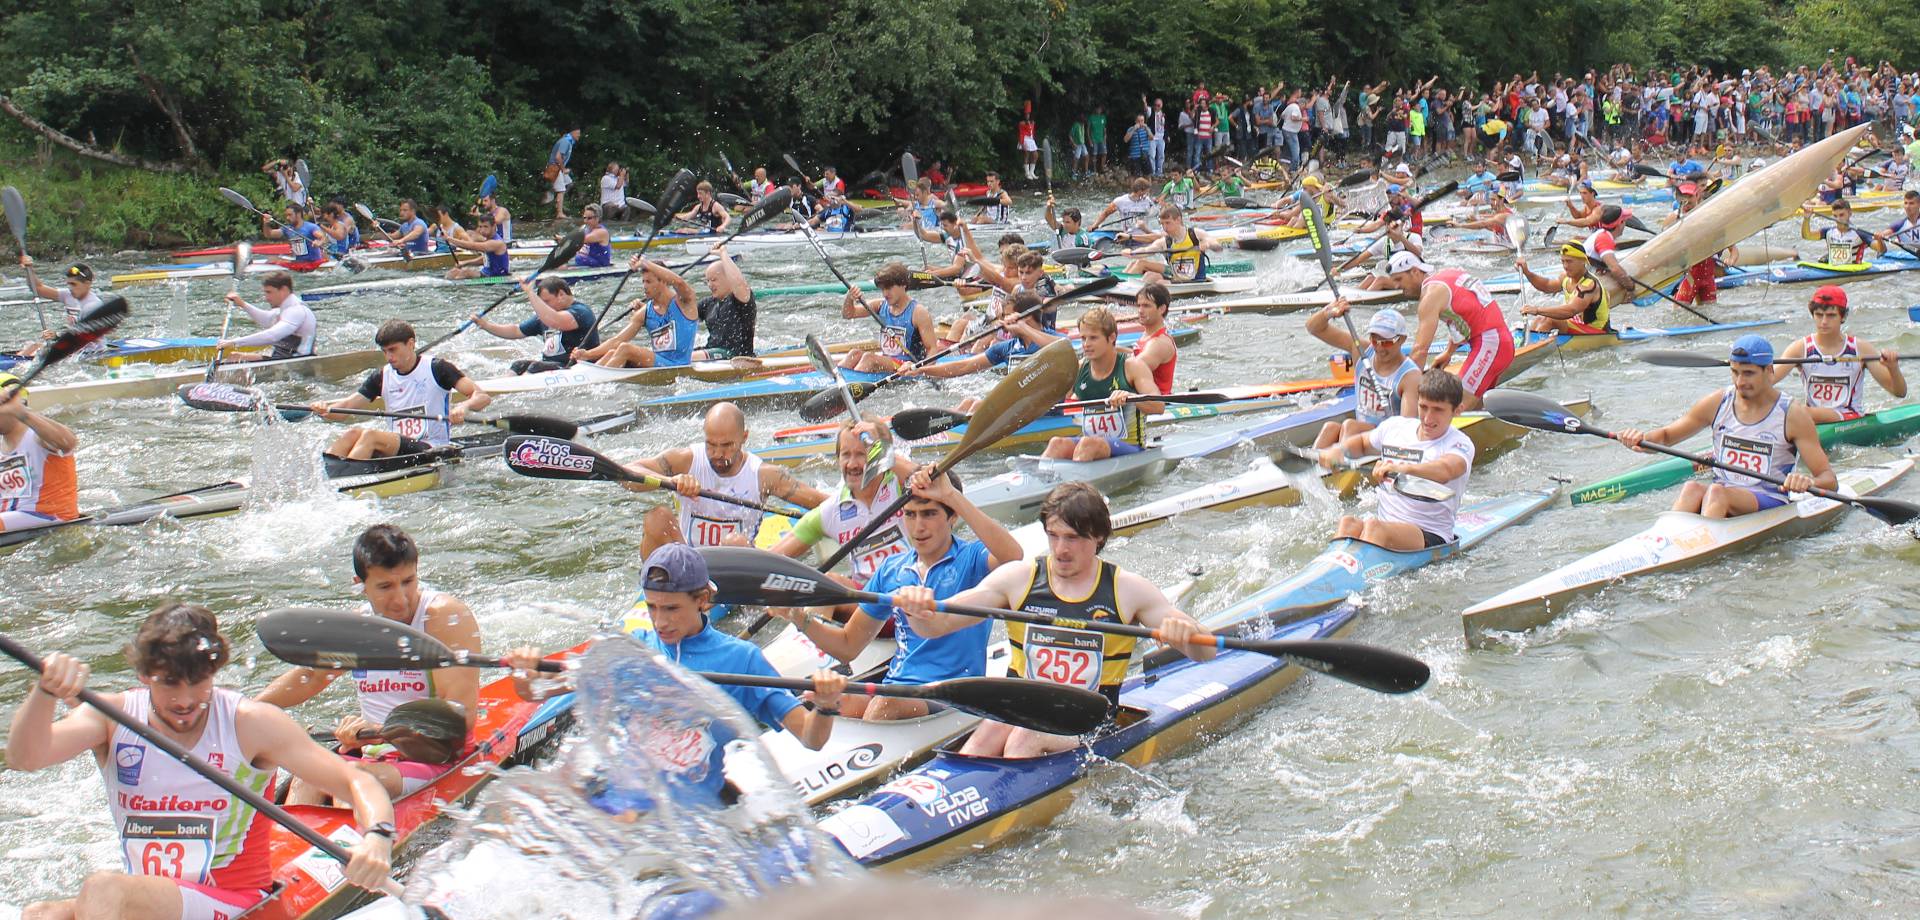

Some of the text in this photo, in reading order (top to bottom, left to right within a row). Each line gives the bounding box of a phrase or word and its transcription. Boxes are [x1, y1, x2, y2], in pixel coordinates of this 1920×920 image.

[1812, 383, 1844, 401] 287
[396, 418, 422, 436] 183
[1088, 415, 1118, 434] 141
[539, 440, 570, 458] Los
[1727, 450, 1763, 475] 253
[0, 469, 25, 490] 96
[697, 521, 735, 546] 107
[1024, 605, 1058, 615] AZZURRI
[1031, 632, 1099, 649] Liber bank
[1036, 648, 1090, 685] 252
[360, 678, 426, 694] Gaitero
[129, 793, 229, 812] Gaitero
[126, 823, 209, 836] Liber bank
[141, 841, 186, 880] 63
